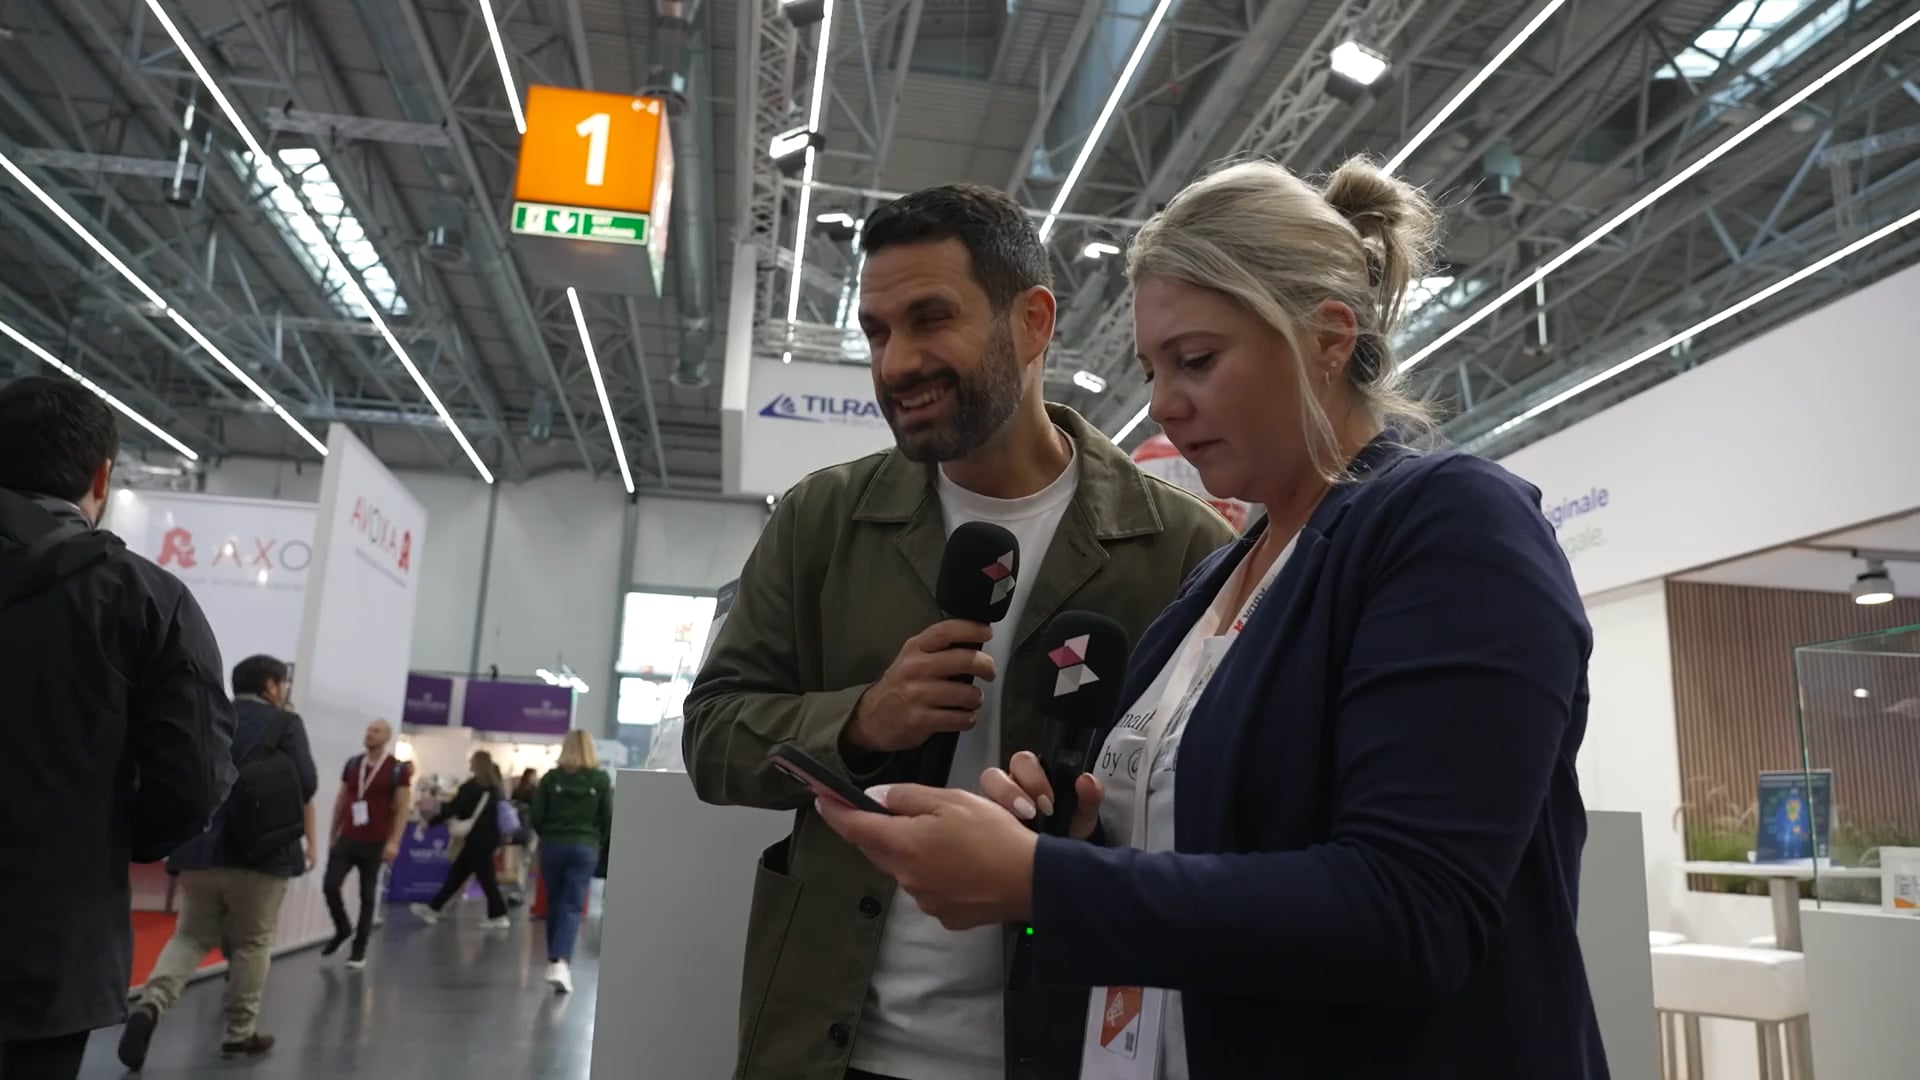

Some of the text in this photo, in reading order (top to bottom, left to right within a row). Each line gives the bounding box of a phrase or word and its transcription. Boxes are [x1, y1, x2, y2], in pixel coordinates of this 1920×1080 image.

[575, 112, 611, 186] 1
[1565, 527, 1608, 560] gale.
[1102, 744, 1122, 777] by
